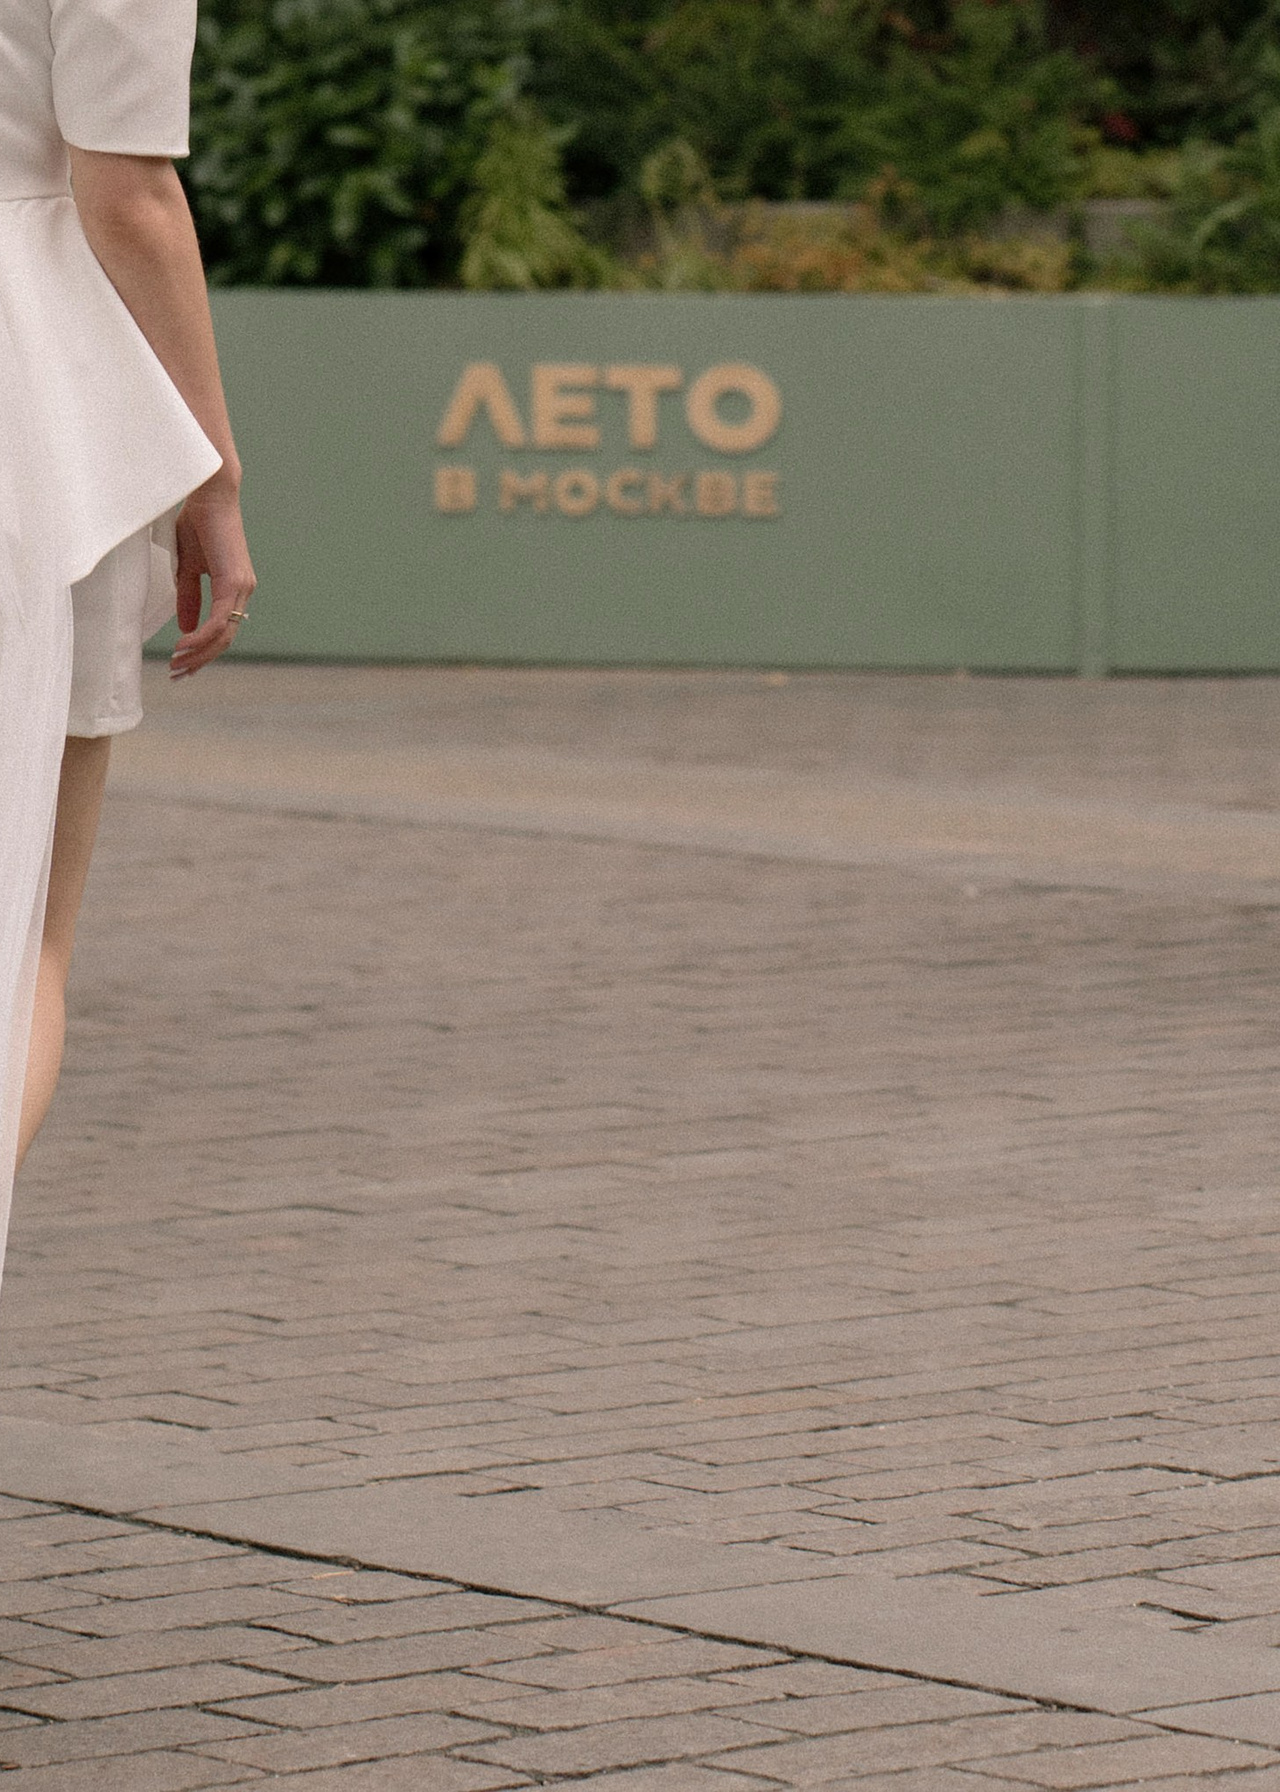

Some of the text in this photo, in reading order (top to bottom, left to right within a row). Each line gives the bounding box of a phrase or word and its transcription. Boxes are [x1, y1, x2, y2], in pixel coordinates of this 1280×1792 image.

[437, 361, 782, 454] ЛЕТО
[434, 465, 779, 517] В МОСКВЕ
